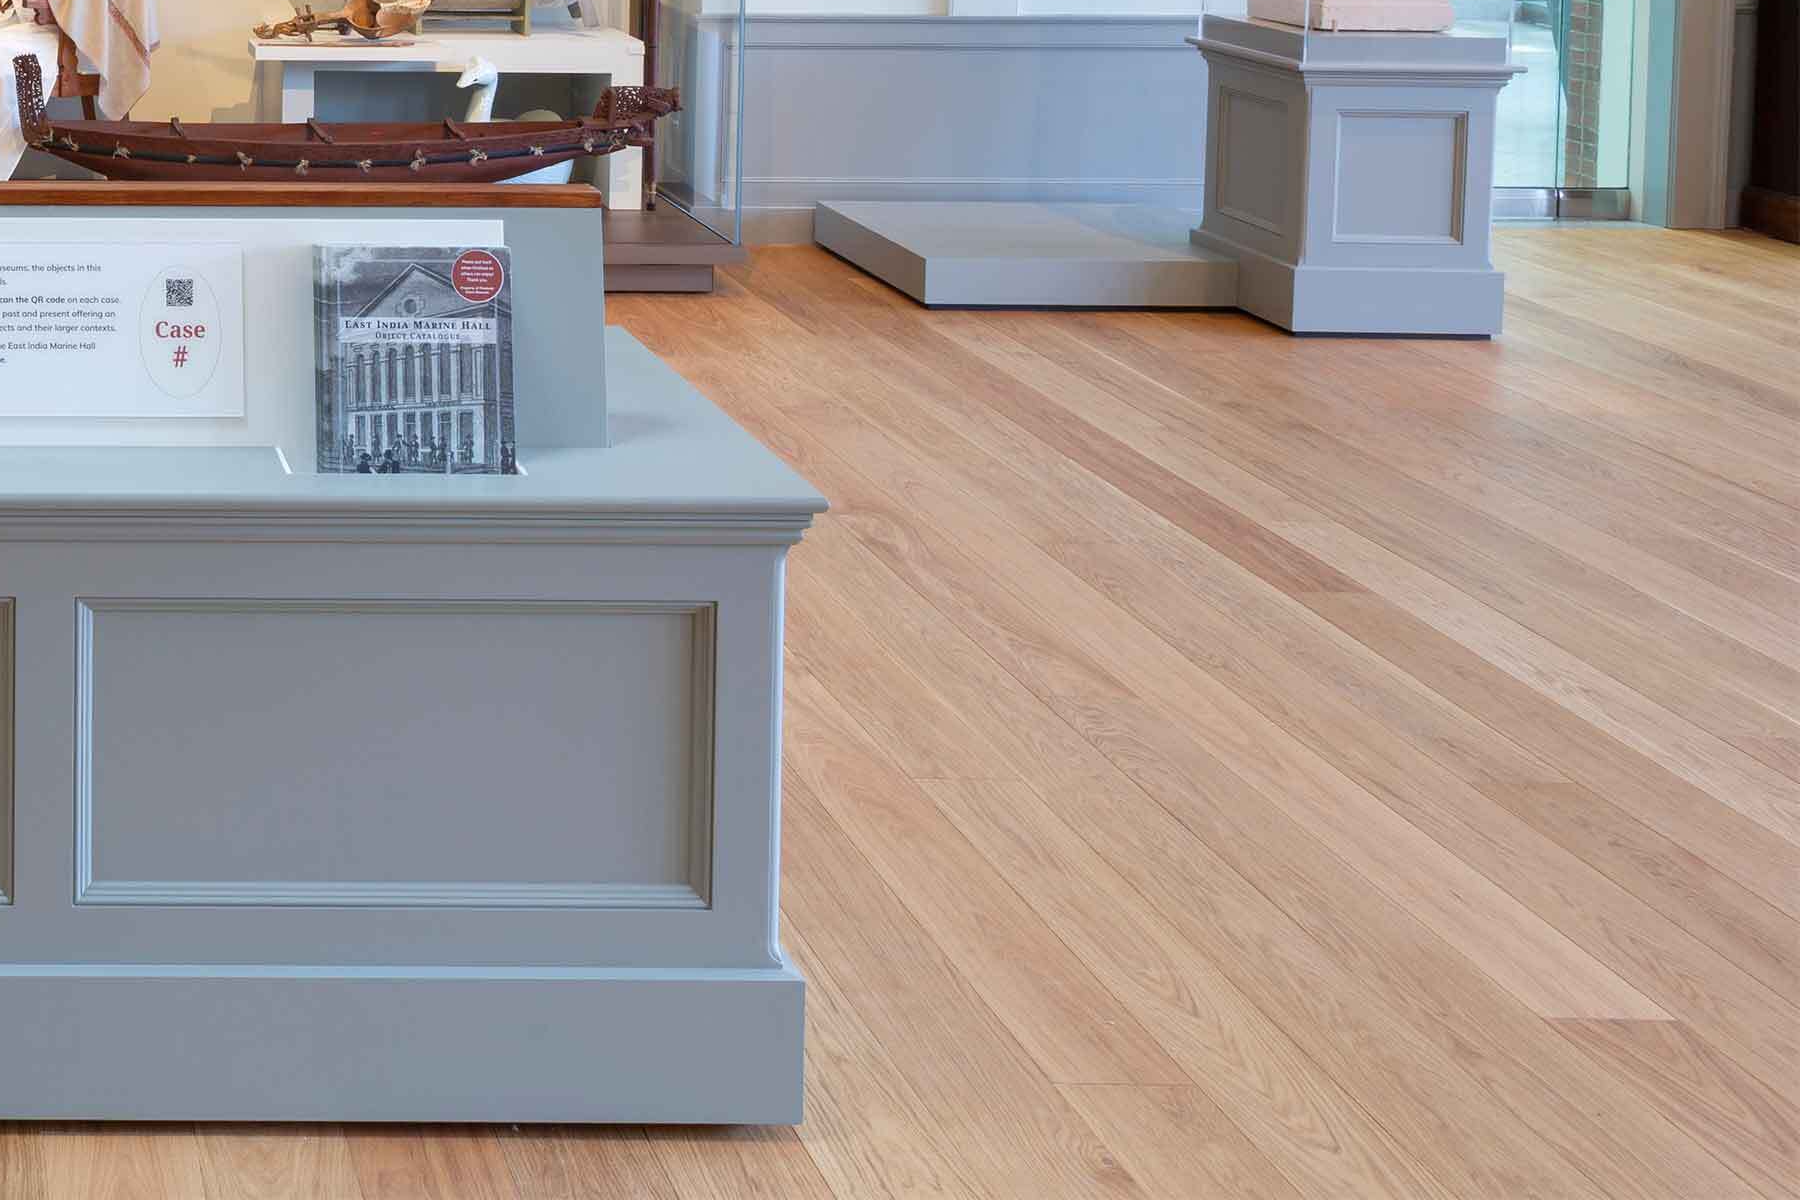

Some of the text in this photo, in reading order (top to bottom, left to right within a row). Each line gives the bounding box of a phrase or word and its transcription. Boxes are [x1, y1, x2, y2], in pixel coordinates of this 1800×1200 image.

[31, 264, 45, 272] the
[46, 264, 75, 272] objects
[77, 264, 85, 272] in
[86, 264, 101, 272] this
[15, 296, 29, 304] the
[31, 296, 44, 304] QR
[46, 296, 65, 304] code
[67, 296, 78, 304] on
[80, 296, 99, 304] each
[2, 310, 20, 318] past
[22, 310, 37, 318] and
[40, 310, 70, 318] present
[72, 310, 103, 318] offering
[104, 310, 116, 318] an
[17, 324, 32, 332] and
[34, 324, 52, 332] their
[54, 324, 78, 332] larger
[154, 320, 206, 338] Case
[345, 320, 491, 330] EAST INDIA MARINE HALL
[375, 332, 460, 340] OBJECT CATALOGUE
[8, 342, 26, 350] East
[28, 342, 48, 350] India
[50, 342, 78, 350] Marine
[80, 342, 96, 350] Hall
[173, 345, 188, 368] #
